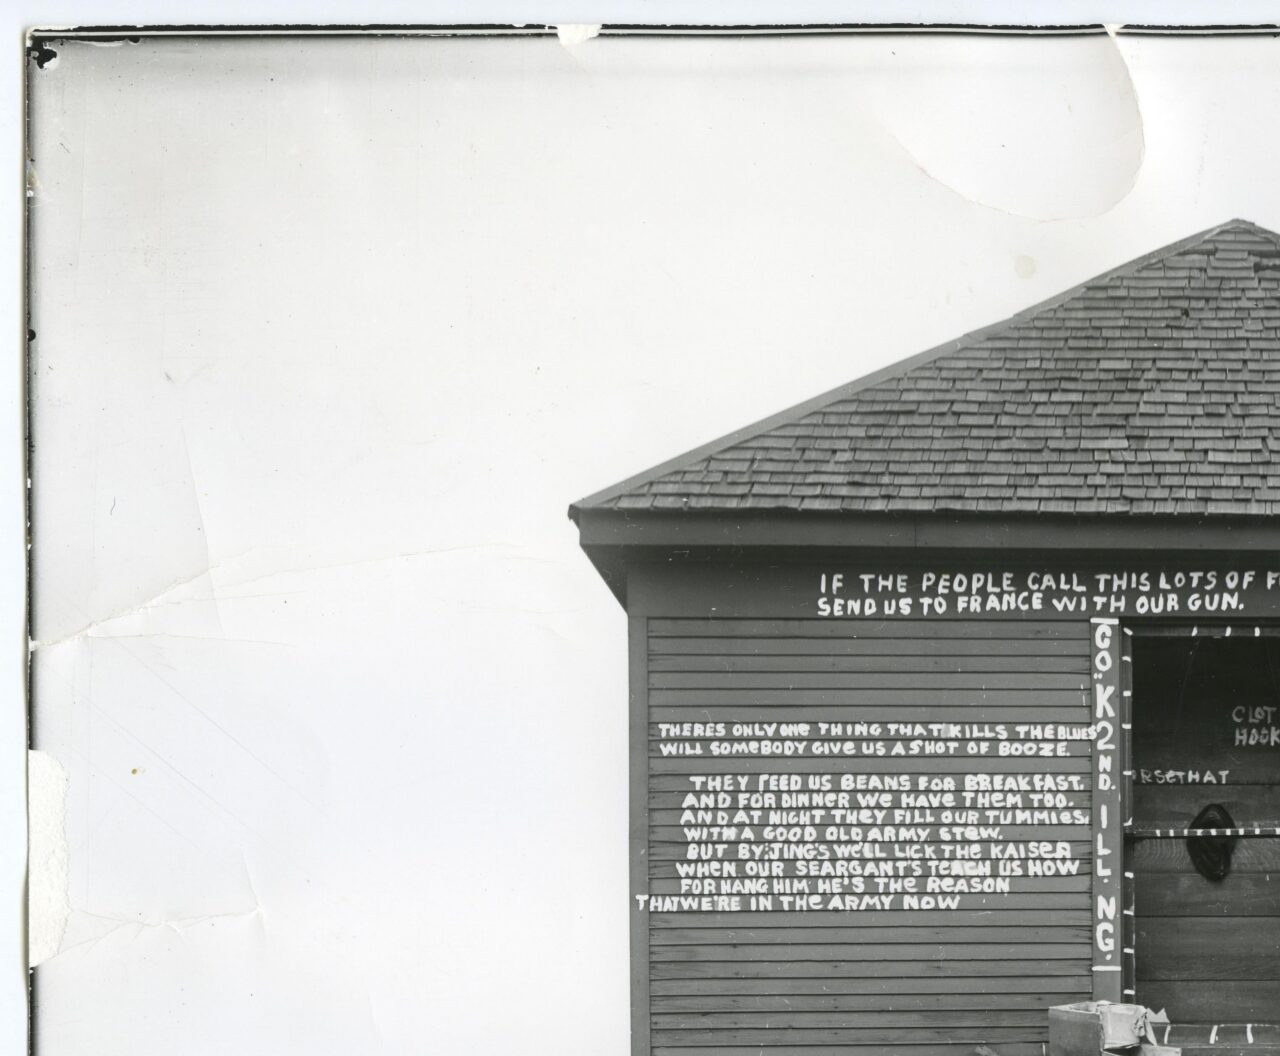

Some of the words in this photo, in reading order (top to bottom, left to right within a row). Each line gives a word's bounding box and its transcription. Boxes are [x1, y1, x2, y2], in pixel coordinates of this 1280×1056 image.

[821, 574, 843, 594] IF
[860, 575, 907, 593] THE
[922, 573, 1015, 594] PEOPLE
[1028, 573, 1086, 592] CALL
[1096, 573, 1150, 592] THIS
[1159, 572, 1216, 590] LOTS
[1226, 572, 1255, 589] OF
[818, 598, 876, 616] SEND
[884, 598, 912, 615] US
[920, 597, 946, 616] TO
[958, 592, 1042, 613] FRANCE
[1052, 595, 1125, 612] WITH
[1136, 594, 1178, 614] OUR
[1188, 592, 1244, 611] GUN.
[690, 775, 748, 791] THEY
[808, 775, 831, 790] US
[841, 775, 910, 790] BEANS
[919, 776, 956, 790] FOR
